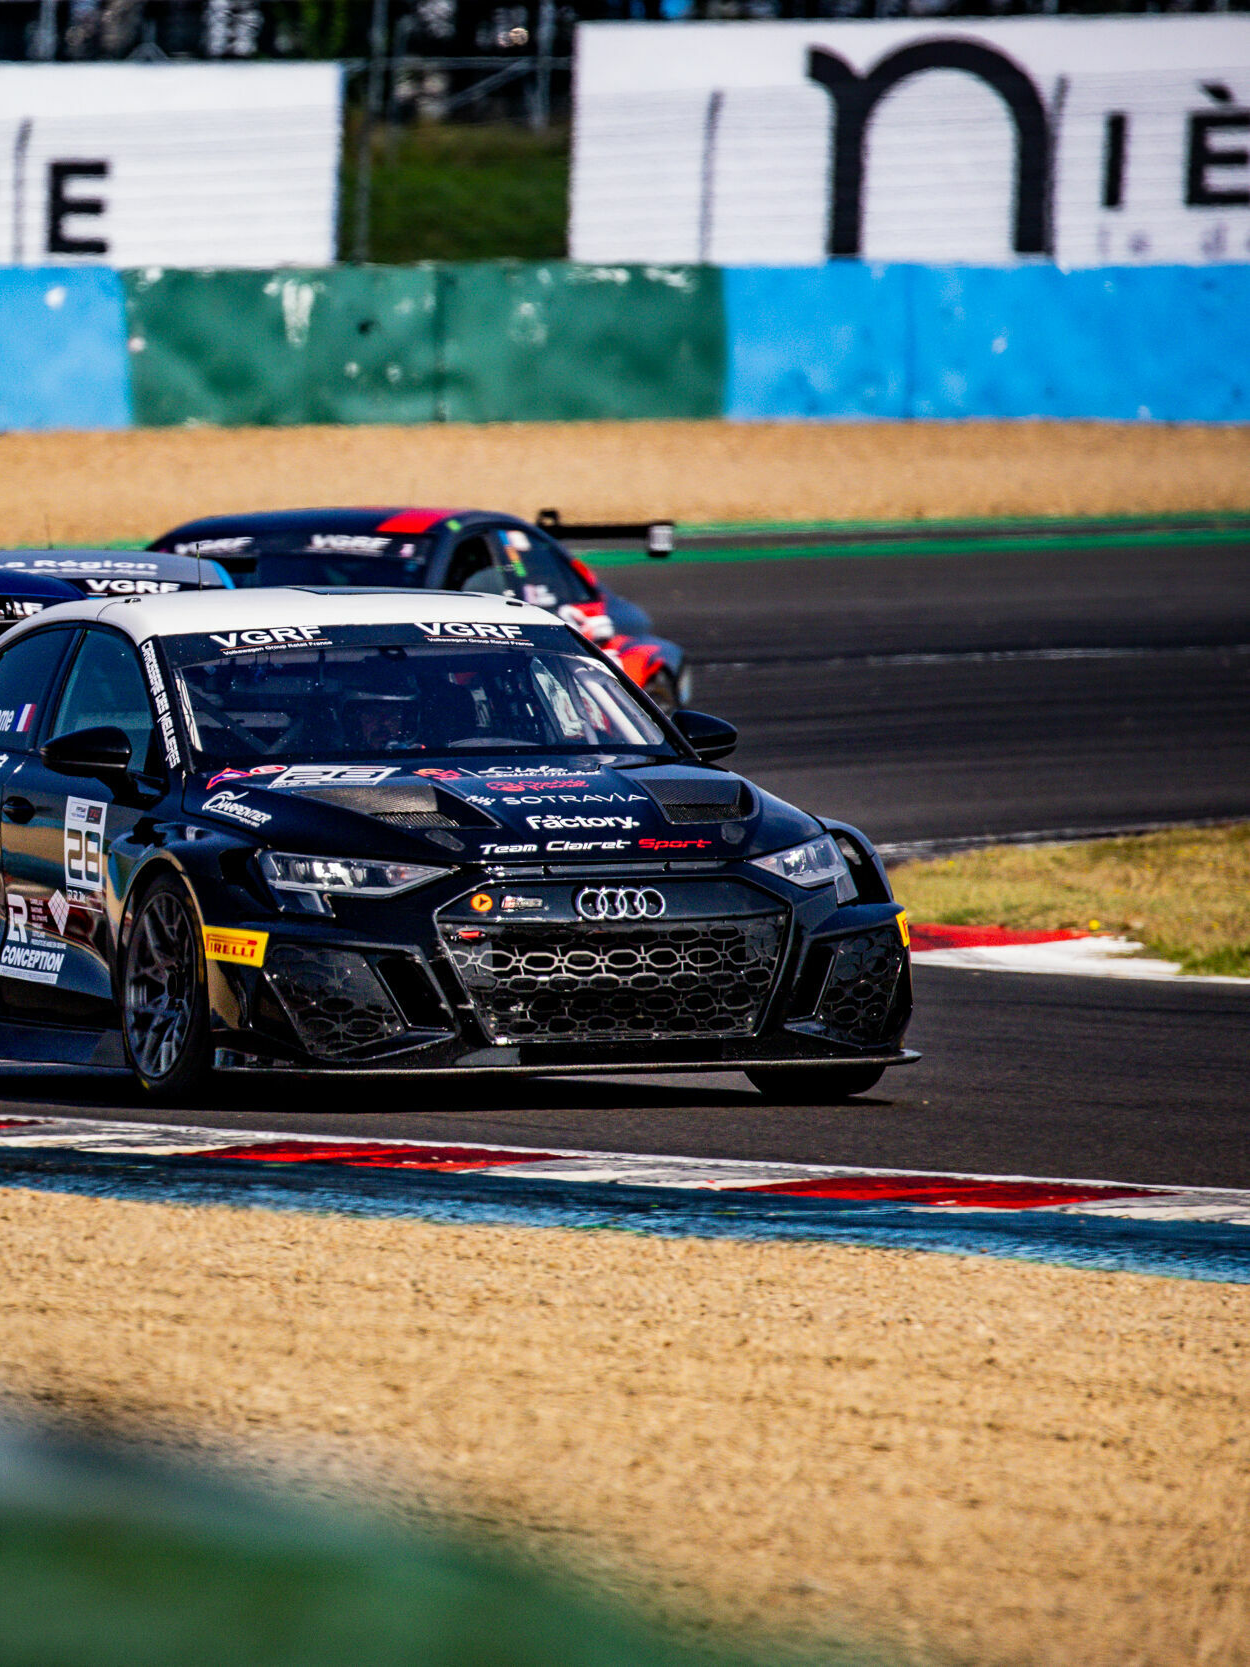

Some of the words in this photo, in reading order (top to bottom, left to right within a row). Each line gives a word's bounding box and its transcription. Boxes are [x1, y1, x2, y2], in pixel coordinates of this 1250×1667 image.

[33, 559, 159, 570] Région
[86, 579, 181, 594] VGRF
[209, 625, 322, 648] VGRF
[413, 621, 523, 639] VGRF
[502, 792, 650, 806] SOTRAVIA
[66, 827, 101, 884] 28
[479, 843, 538, 855] Team
[546, 839, 631, 851] Clairet
[638, 838, 712, 851] Sport
[205, 933, 258, 958] PIRELLI
[0, 944, 65, 972] CONCEPTION
